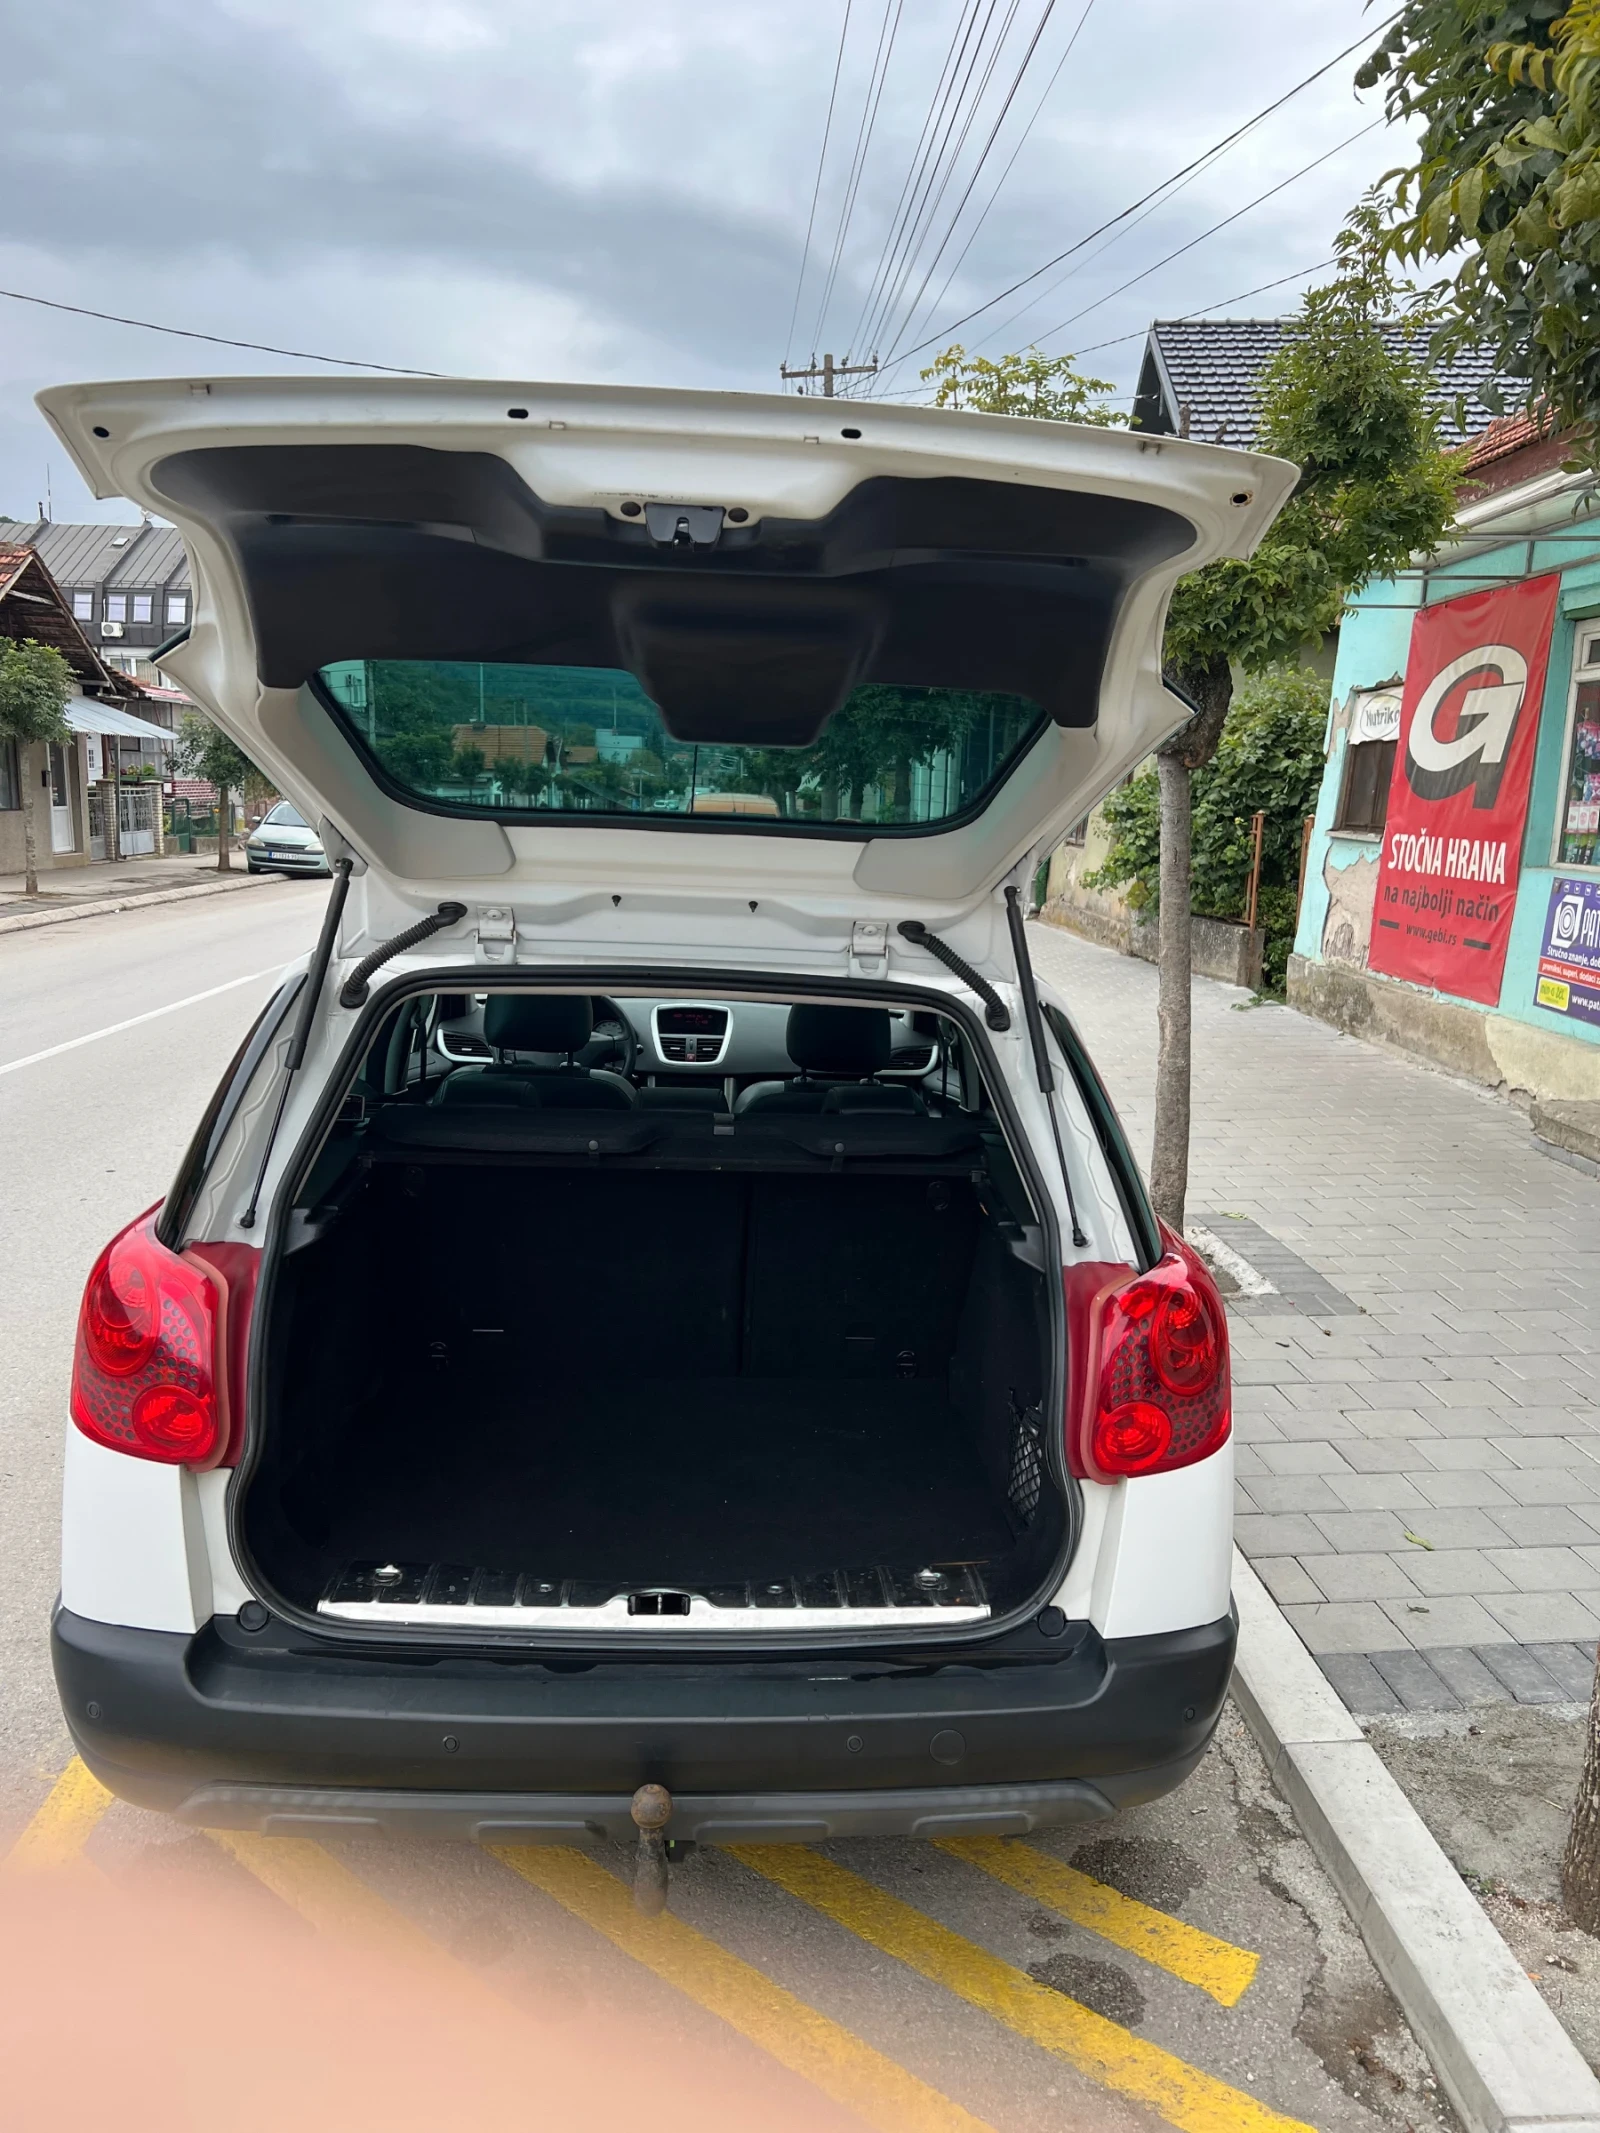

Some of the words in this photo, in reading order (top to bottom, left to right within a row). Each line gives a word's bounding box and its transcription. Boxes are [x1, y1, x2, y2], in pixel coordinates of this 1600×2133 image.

[1387, 827, 1443, 876] STOČNA
[1444, 837, 1507, 885] HRANA
[1384, 885, 1399, 904] na
[1401, 885, 1454, 919] najbolji
[1456, 894, 1500, 922] način
[1406, 923, 1457, 946] www.gebi.rs
